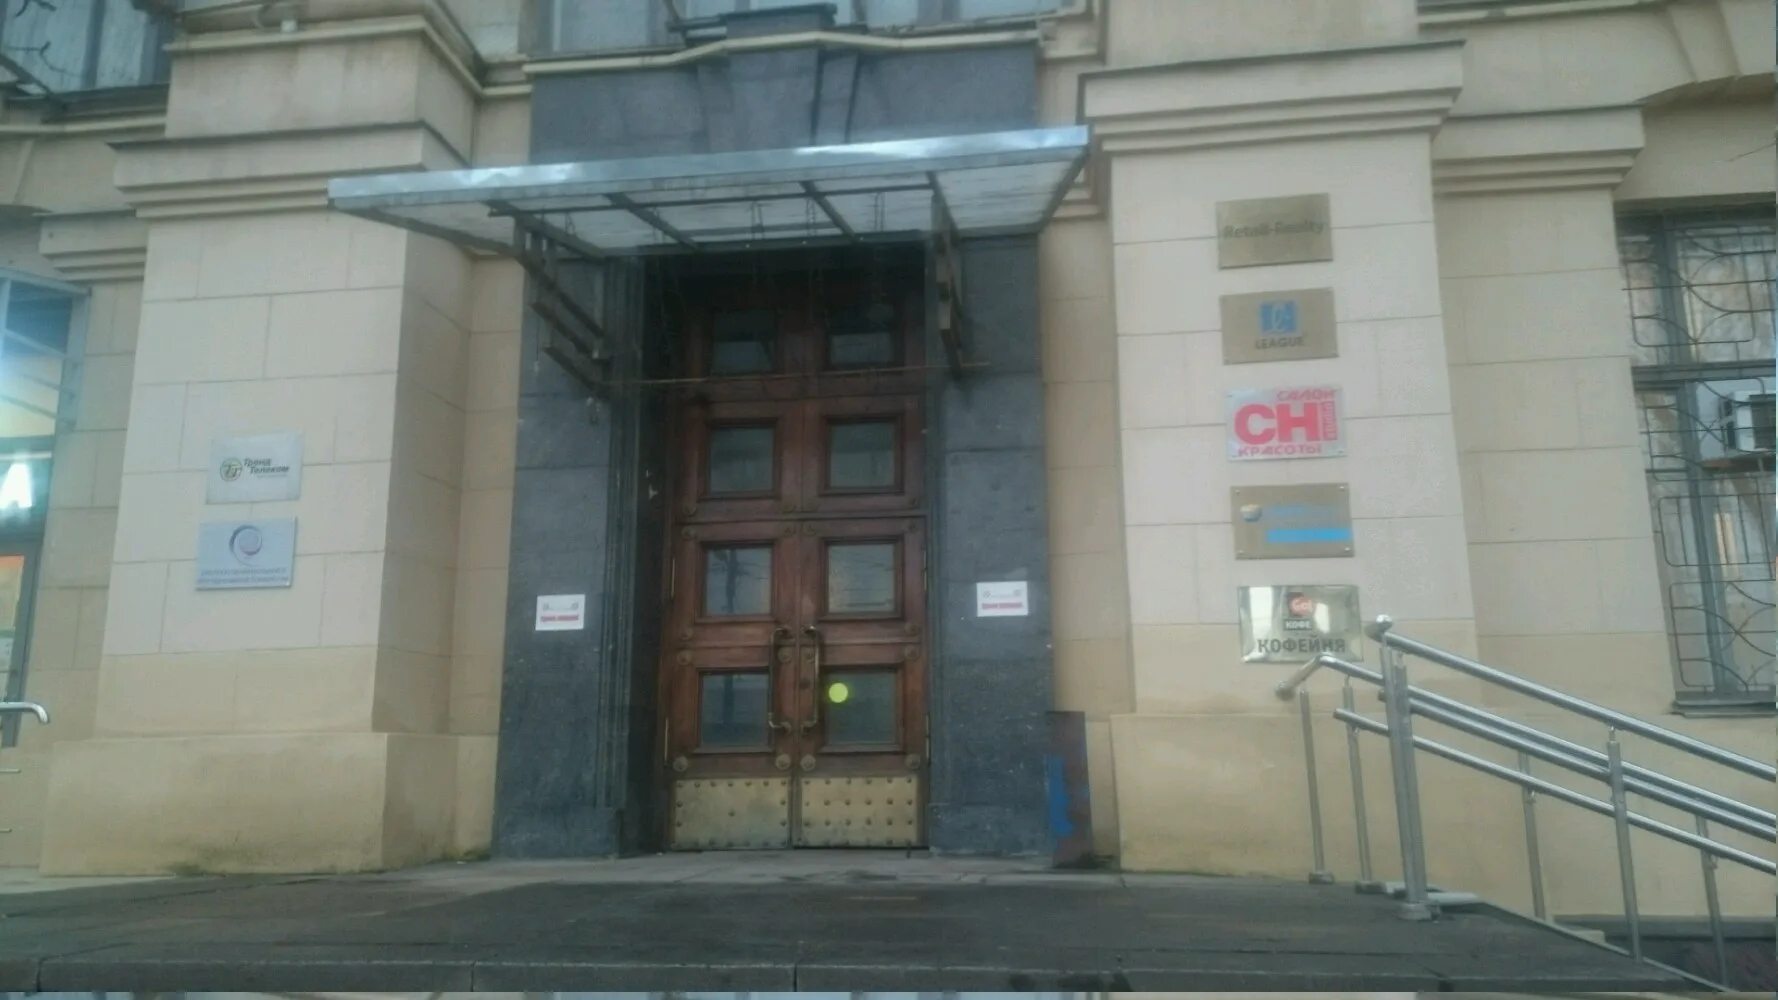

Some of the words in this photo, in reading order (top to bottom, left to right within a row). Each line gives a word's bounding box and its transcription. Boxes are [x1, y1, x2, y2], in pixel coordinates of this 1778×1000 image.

[1255, 336, 1304, 350] LEAGUE
[1277, 388, 1335, 401] САЛОН
[1238, 444, 1322, 456] КРАСОТЫ
[1285, 620, 1312, 629] КОФЕ
[1257, 635, 1346, 653] КОФЕЙНЯ
